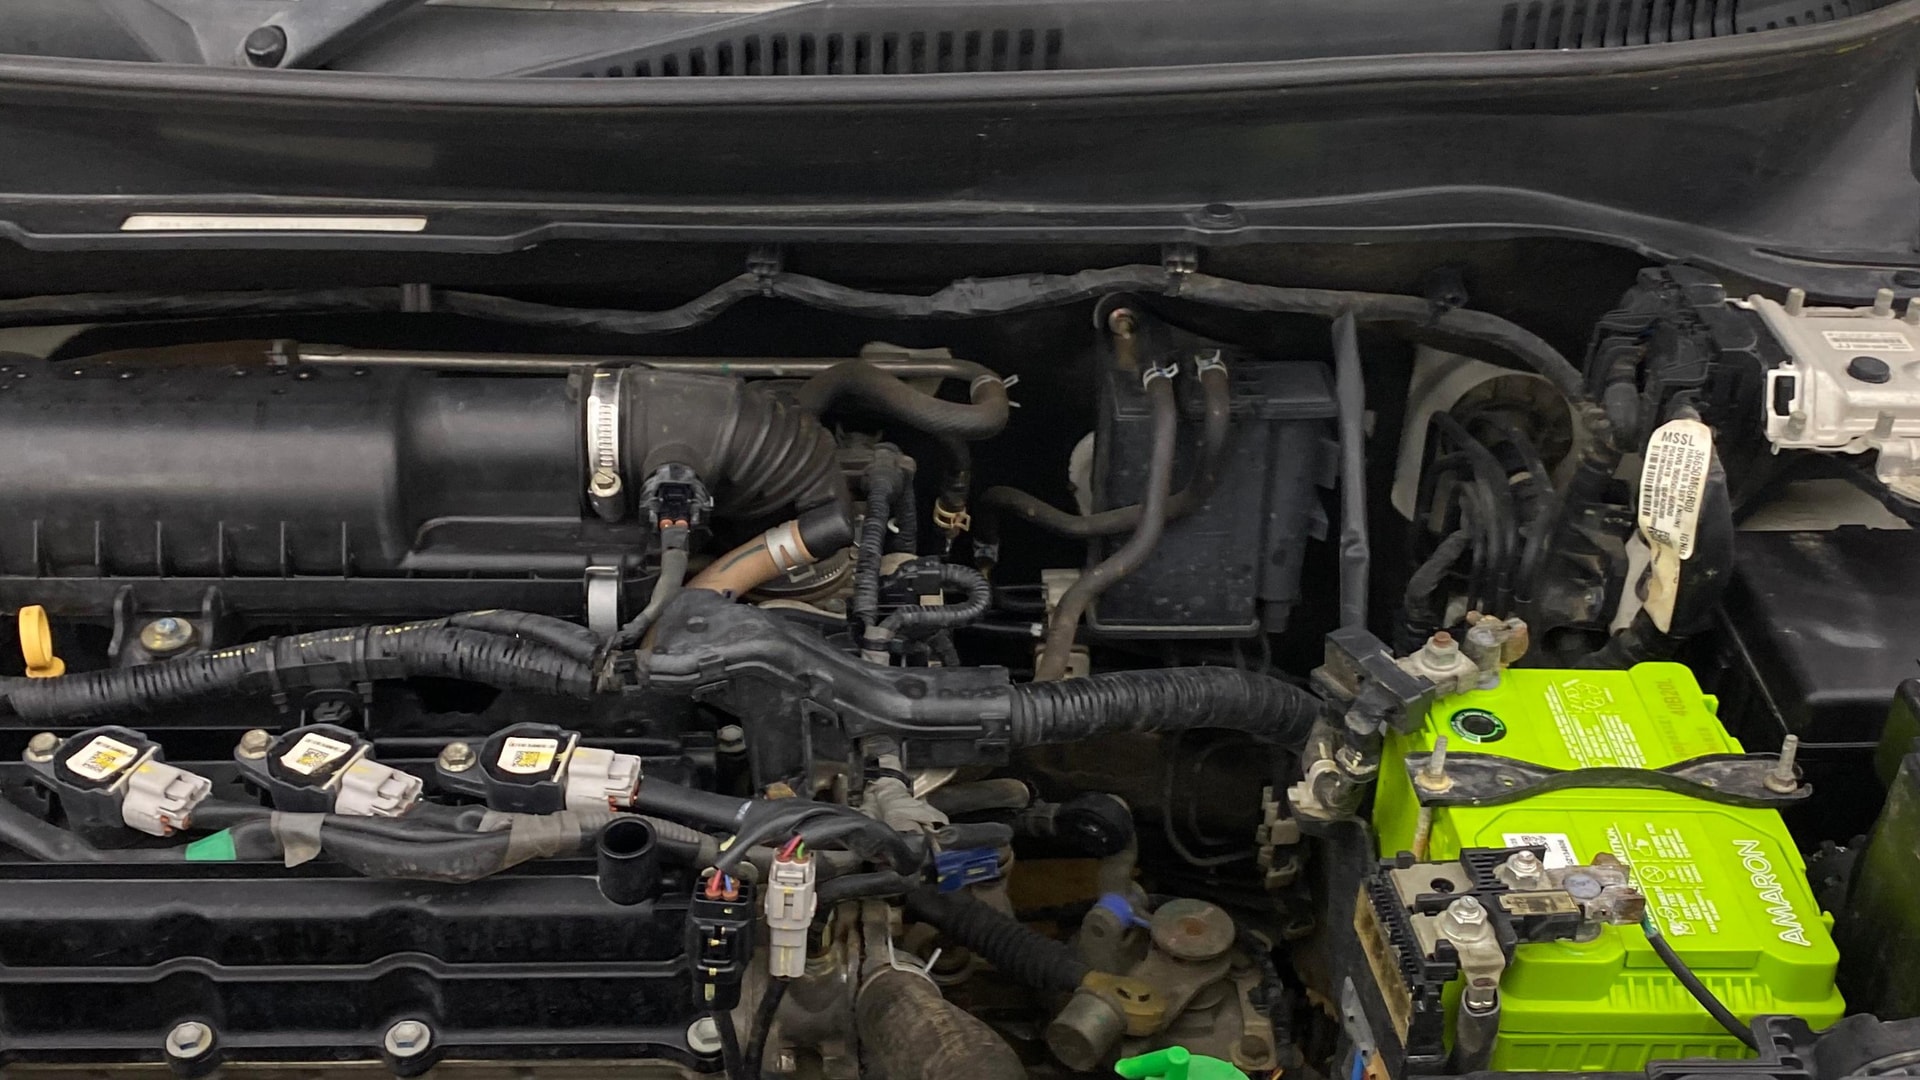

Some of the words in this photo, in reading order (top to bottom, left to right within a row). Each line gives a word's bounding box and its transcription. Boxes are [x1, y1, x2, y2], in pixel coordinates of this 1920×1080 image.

[1661, 431, 1695, 447] MSSL
[1684, 449, 1705, 513] 36650M66R00
[1606, 827, 1630, 865] AUTION
[1732, 840, 1812, 947] AMARON
